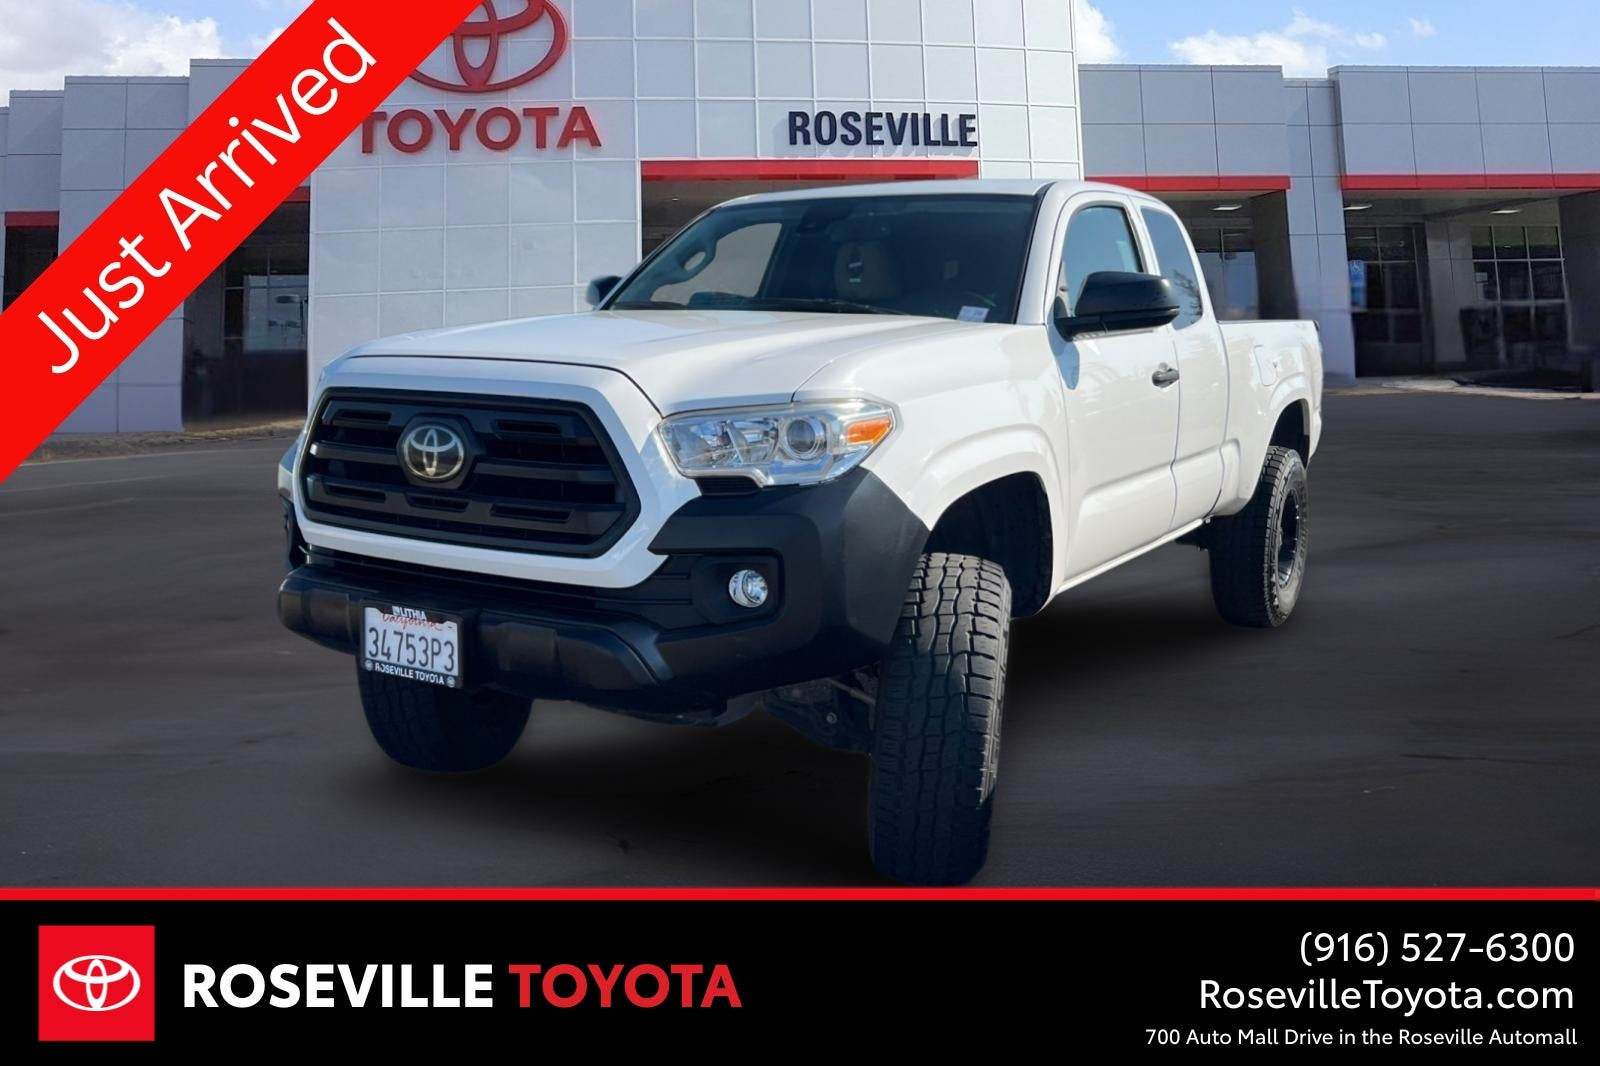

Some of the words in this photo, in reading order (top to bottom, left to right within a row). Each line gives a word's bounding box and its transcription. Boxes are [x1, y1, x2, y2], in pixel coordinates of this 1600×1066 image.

[361, 106, 602, 154] TOYOTA
[788, 111, 978, 147] ROSEVILLE
[368, 627, 455, 673] 34753P3
[374, 663, 414, 679] ROSEVILLE
[415, 671, 445, 685] TOYOTA
